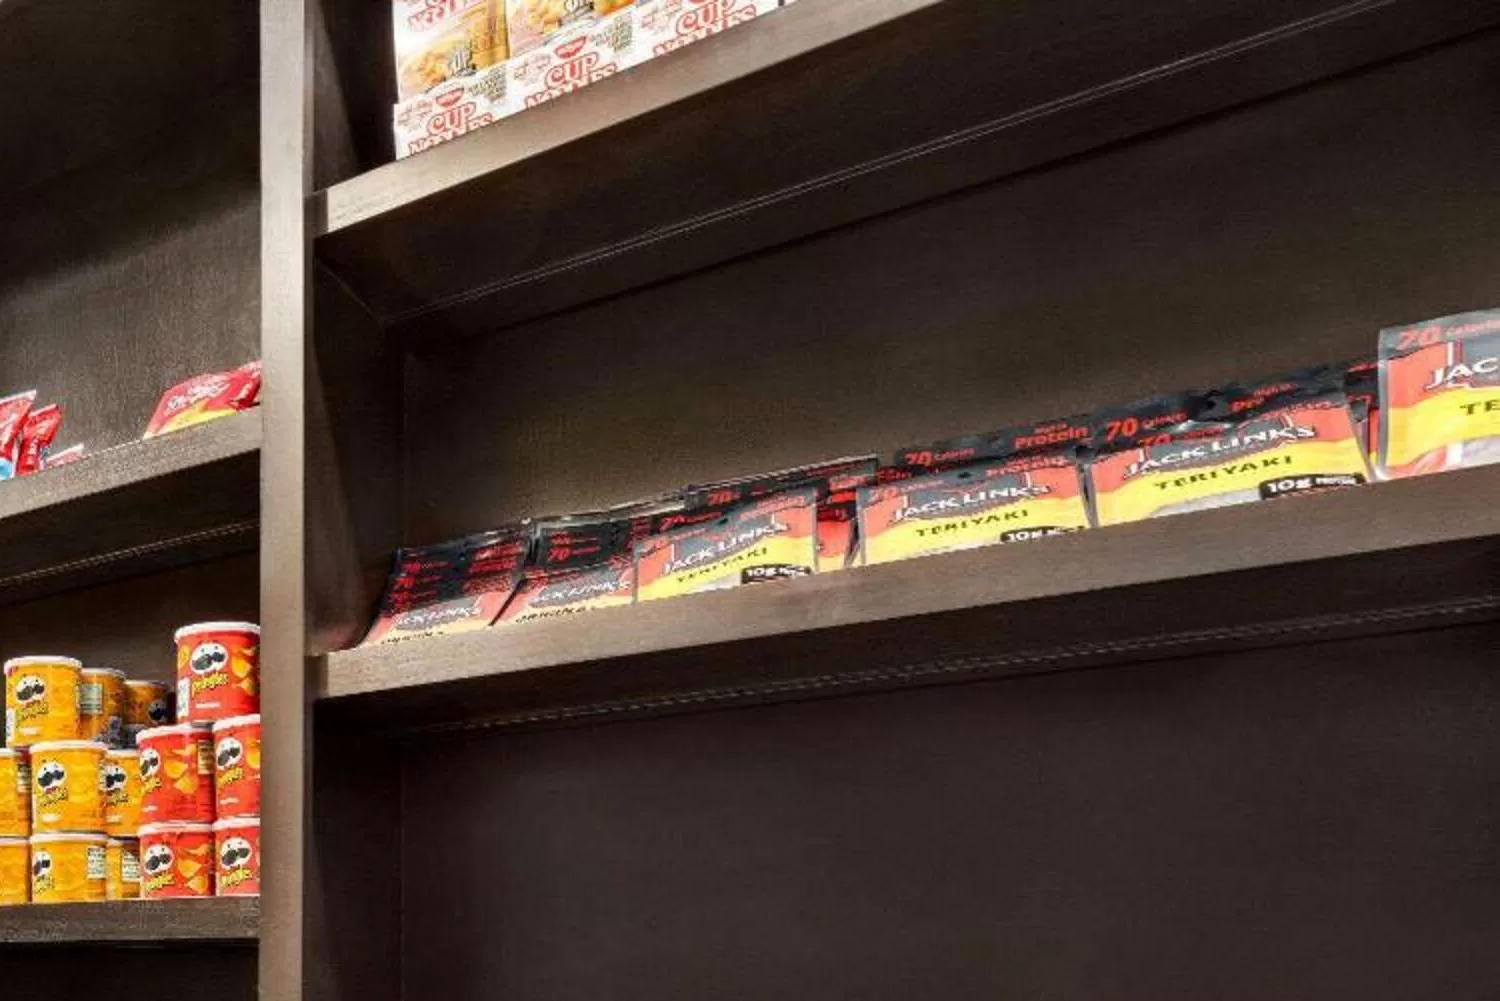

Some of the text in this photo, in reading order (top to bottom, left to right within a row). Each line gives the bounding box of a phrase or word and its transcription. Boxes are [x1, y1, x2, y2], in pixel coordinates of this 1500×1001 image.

[545, 52, 600, 90] CUP
[427, 102, 476, 135] CUP
[1107, 419, 1138, 441] 70
[1123, 446, 1205, 480] JACK
[1154, 455, 1293, 490] TERIYAKI
[891, 495, 960, 523] JACK
[915, 508, 1030, 536] TERIYAKI
